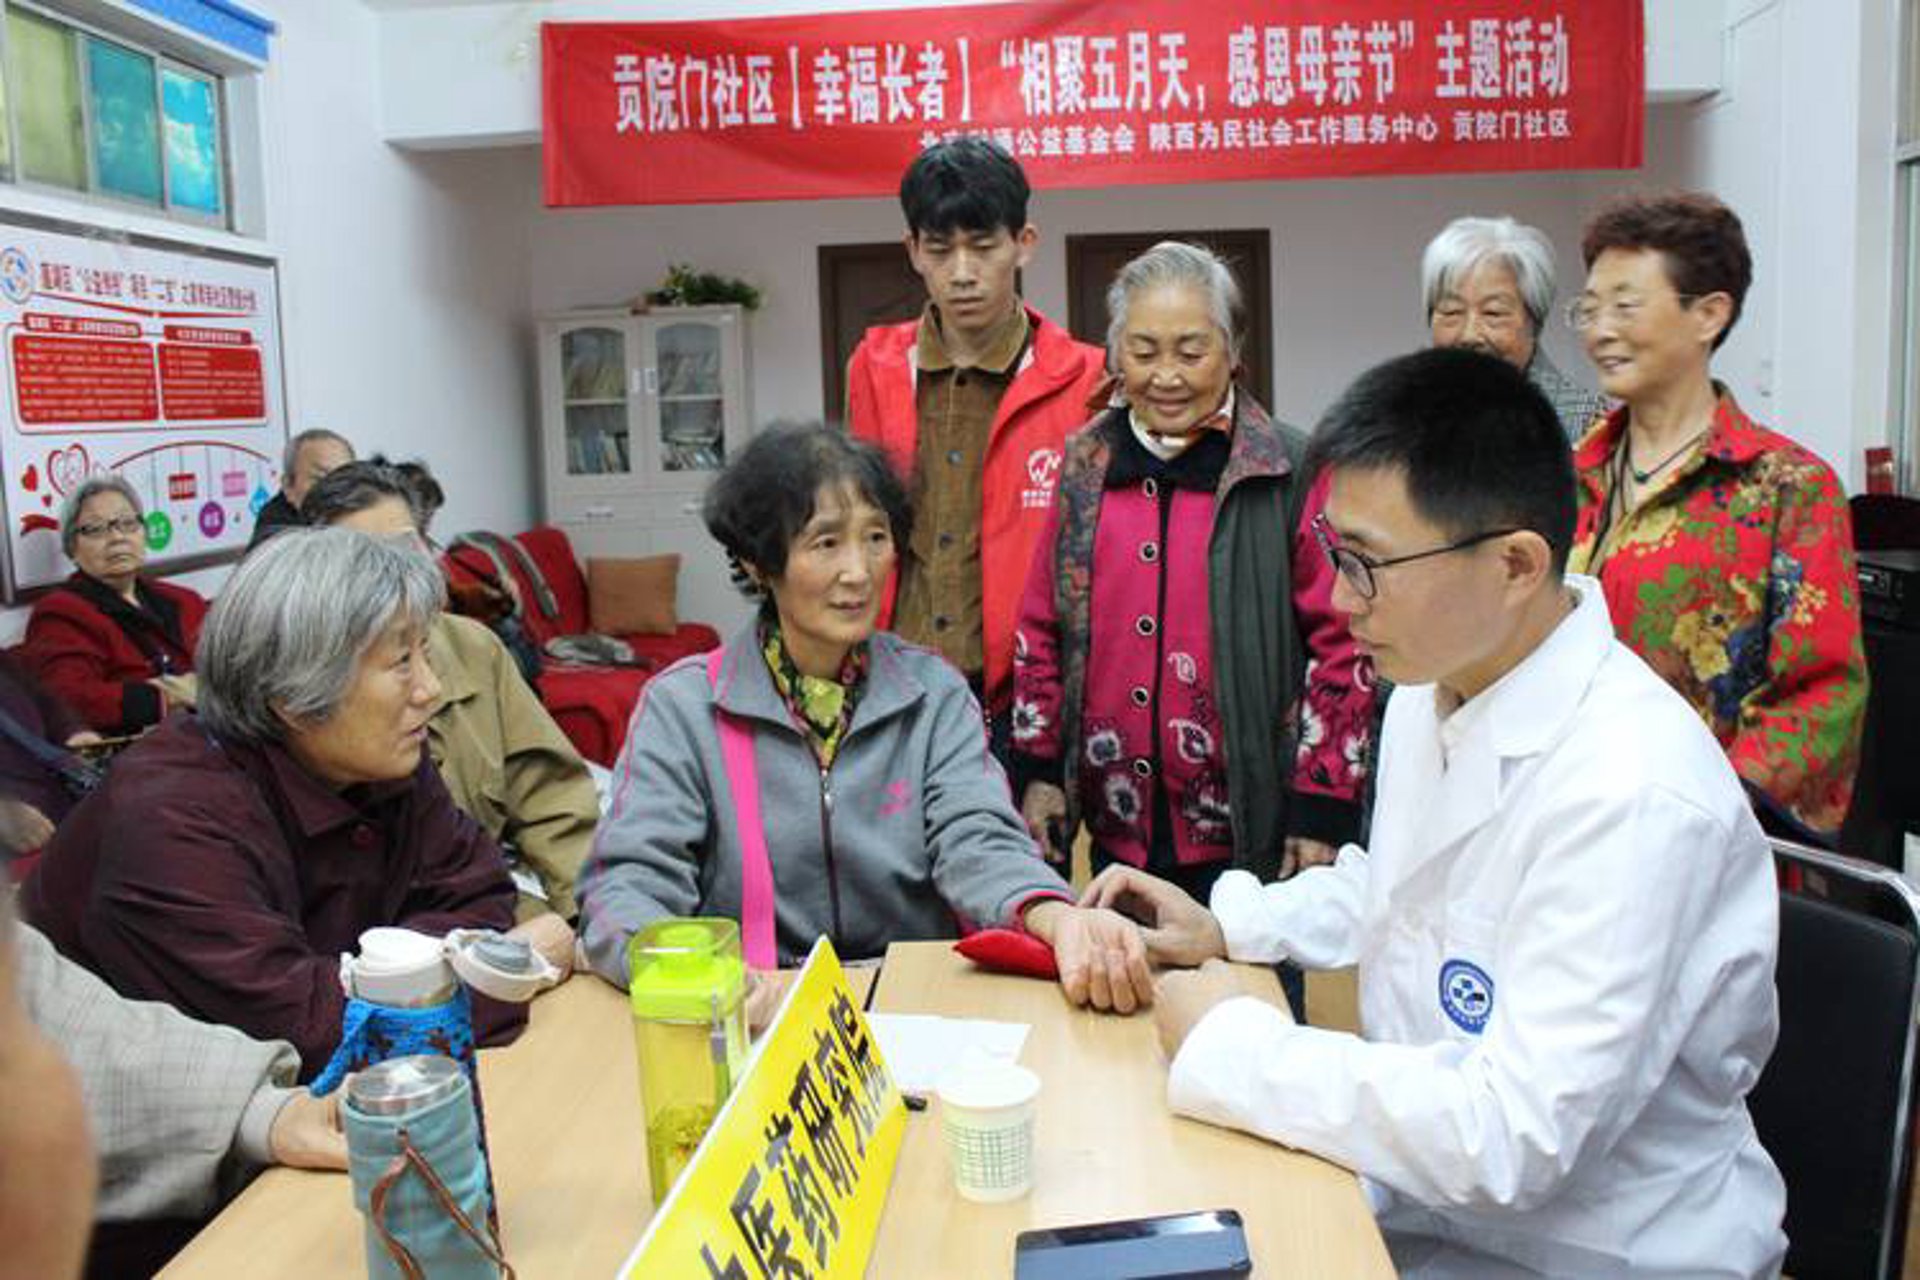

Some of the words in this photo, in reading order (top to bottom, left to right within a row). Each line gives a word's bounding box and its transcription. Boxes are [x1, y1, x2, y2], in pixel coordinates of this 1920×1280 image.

[1453, 108, 1571, 142] 贡院门社区
